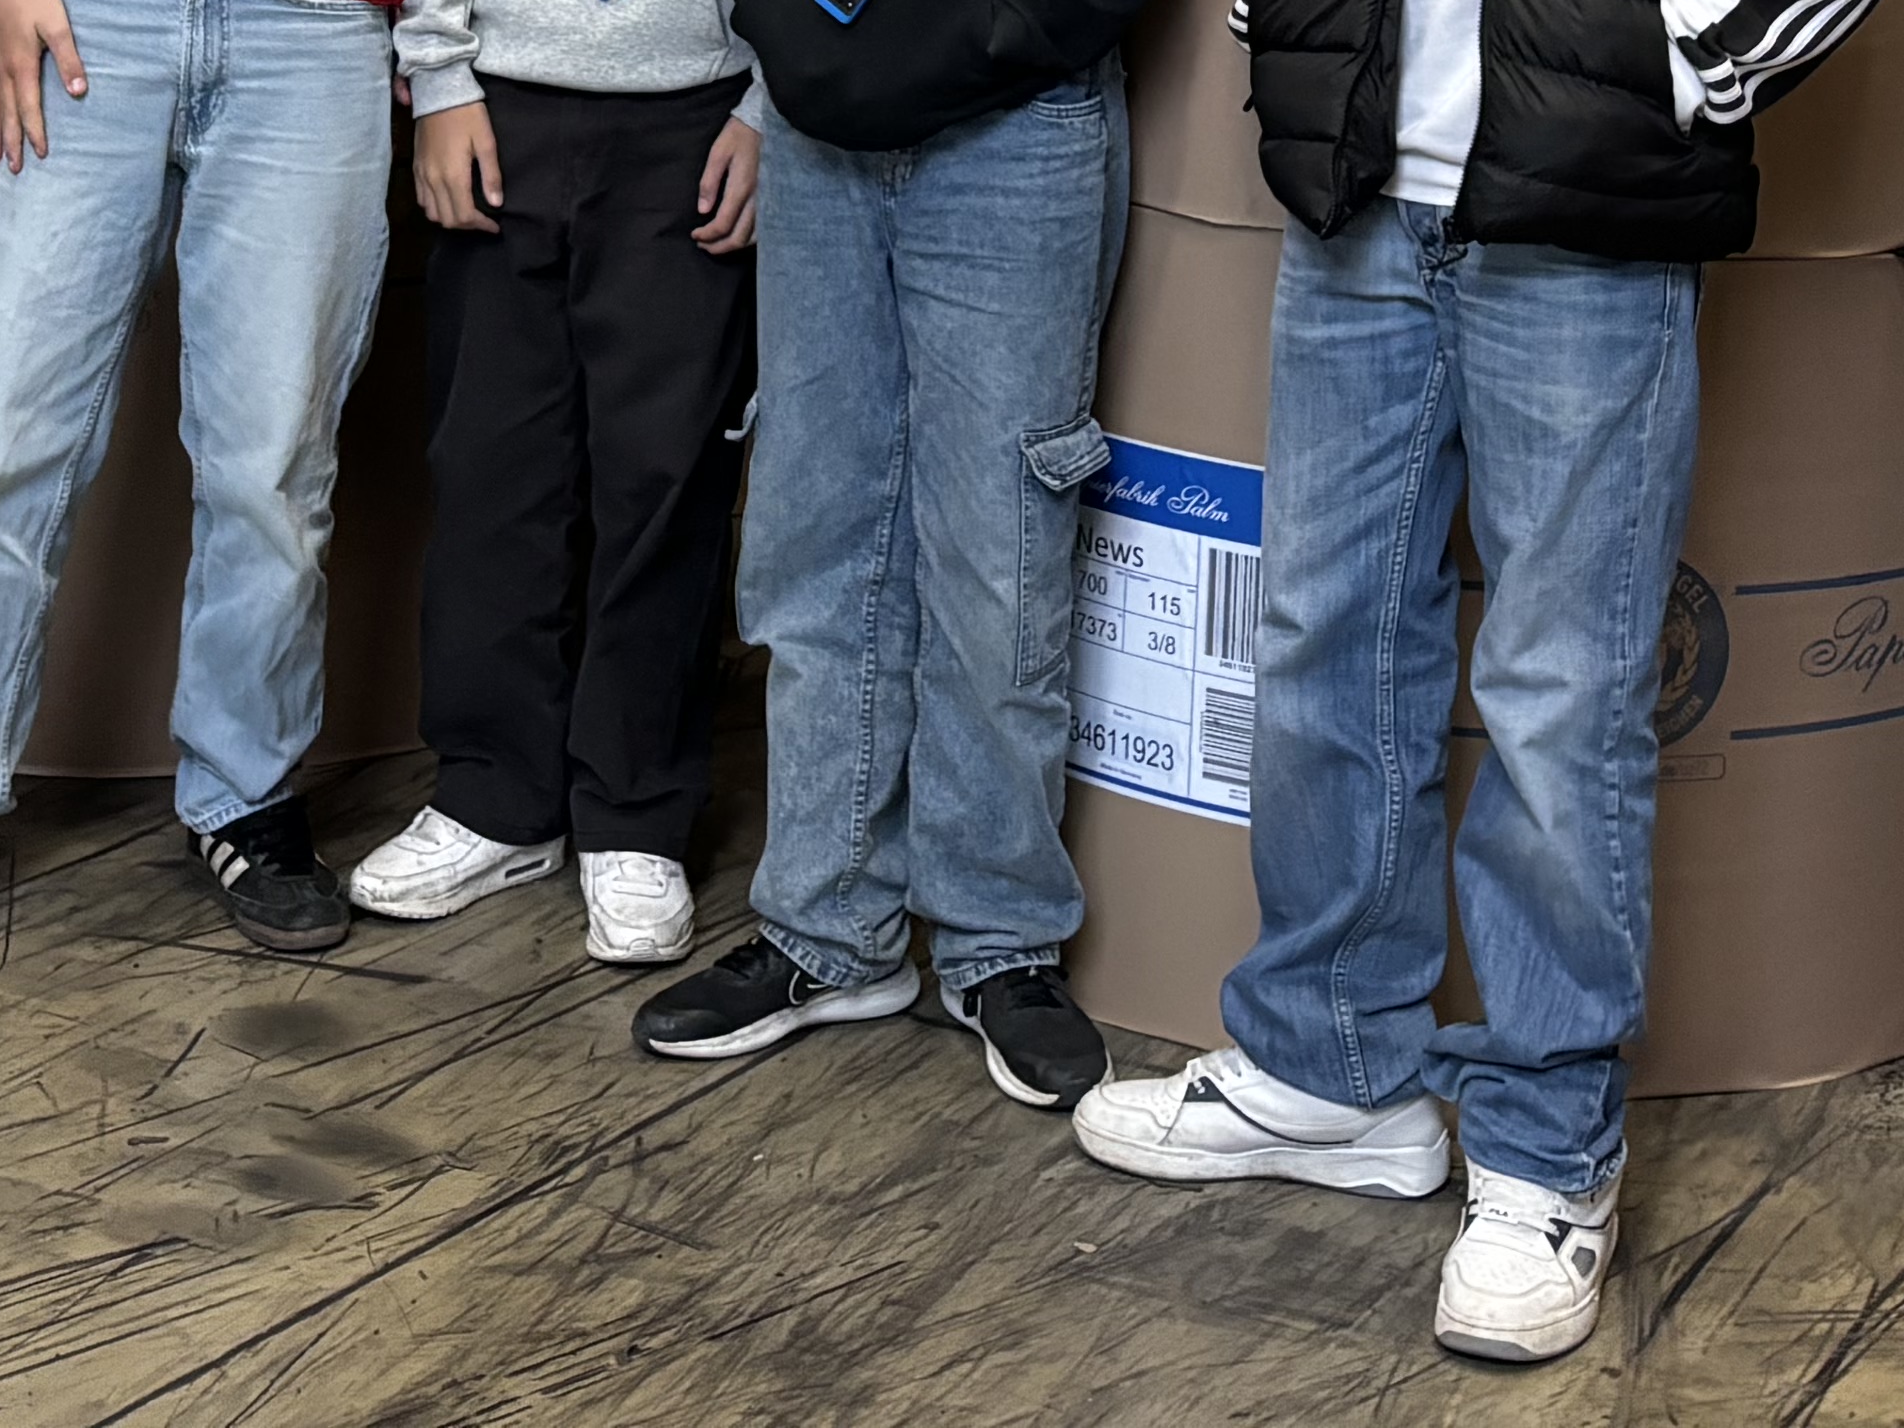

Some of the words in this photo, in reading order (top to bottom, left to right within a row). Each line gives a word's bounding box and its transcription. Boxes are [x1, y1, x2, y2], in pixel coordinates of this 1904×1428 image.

[1166, 485, 1230, 523] Palm
[1077, 522, 1145, 568] News
[1077, 571, 1108, 596] 700
[1147, 592, 1182, 616] 115
[1072, 611, 1117, 642] 17373
[1147, 631, 1177, 655] 3/8
[1069, 715, 1175, 771] 34611923
